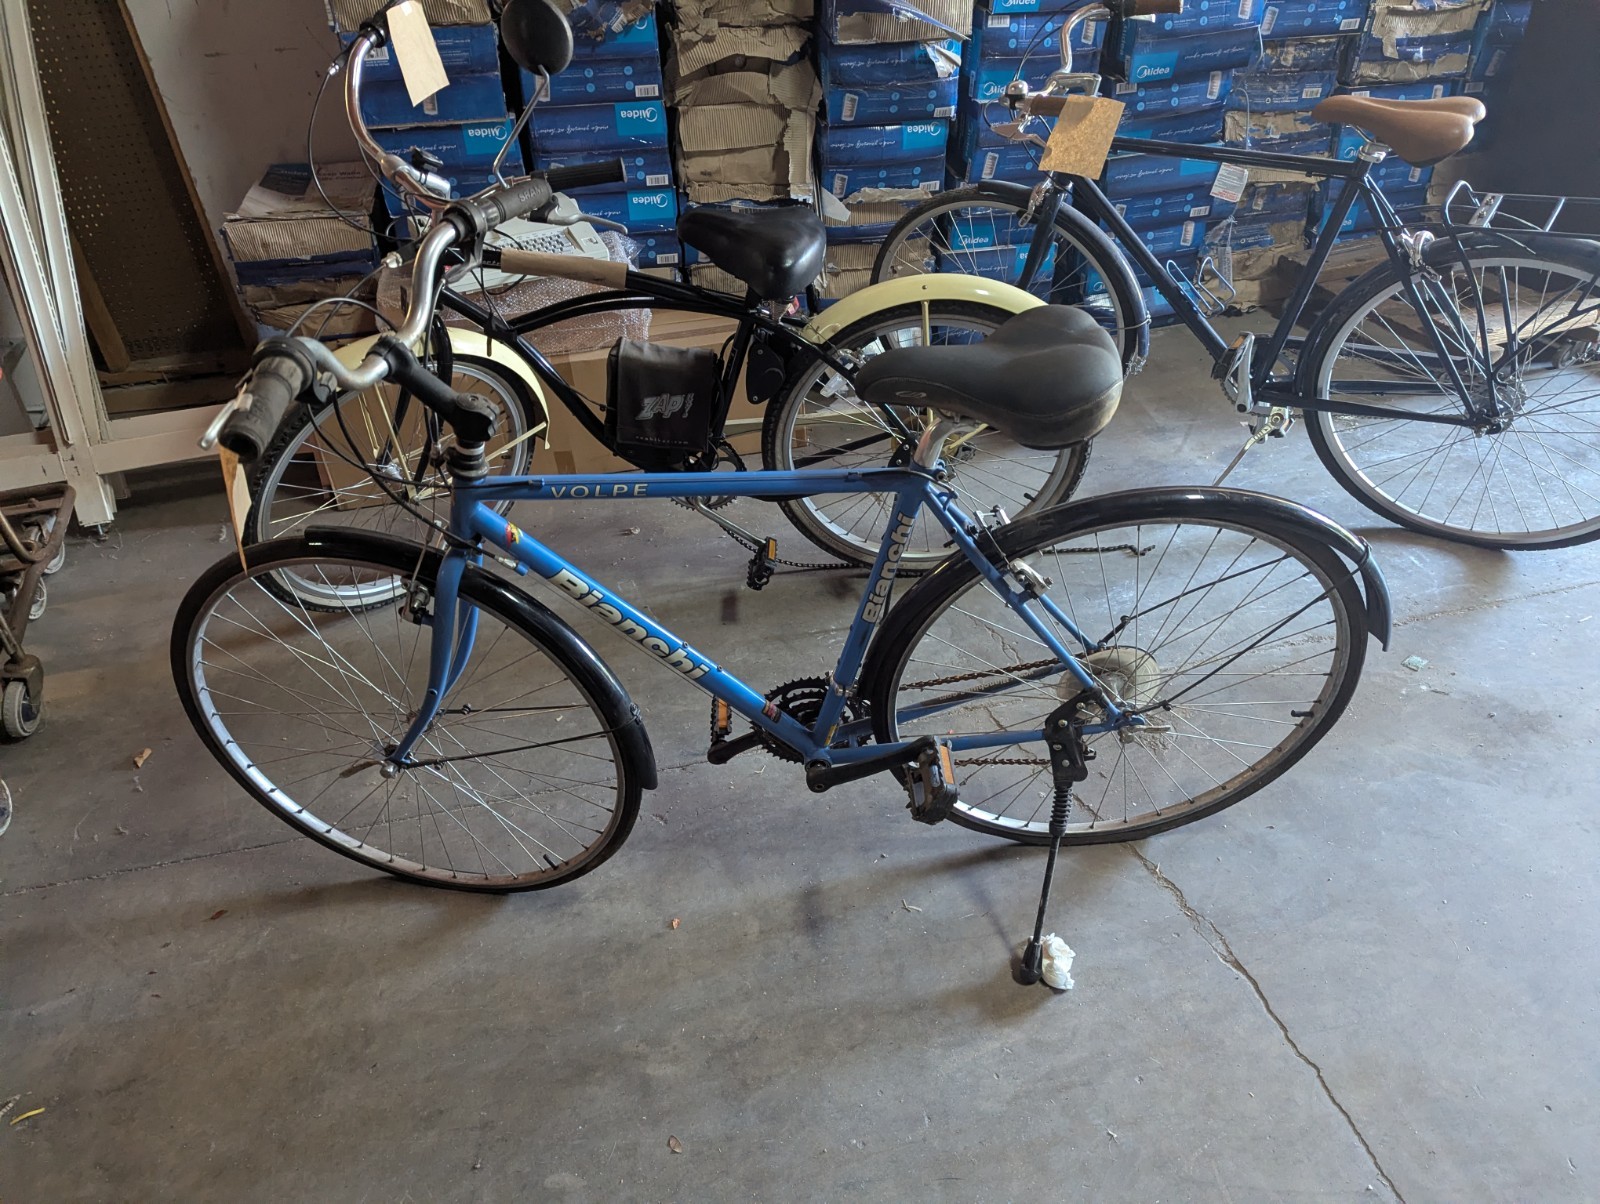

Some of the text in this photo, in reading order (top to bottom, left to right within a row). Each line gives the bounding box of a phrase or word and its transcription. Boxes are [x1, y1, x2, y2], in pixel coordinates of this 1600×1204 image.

[1136, 65, 1170, 79] Midea
[983, 82, 1007, 96] Mid
[620, 107, 658, 123] Midea
[467, 125, 508, 141] Midea
[907, 122, 941, 136] Midea
[632, 193, 668, 208] Midea
[958, 234, 989, 246] Midea
[551, 483, 649, 498] VOLPE
[861, 512, 915, 624] Bianchi
[549, 568, 711, 680] Bianchi
